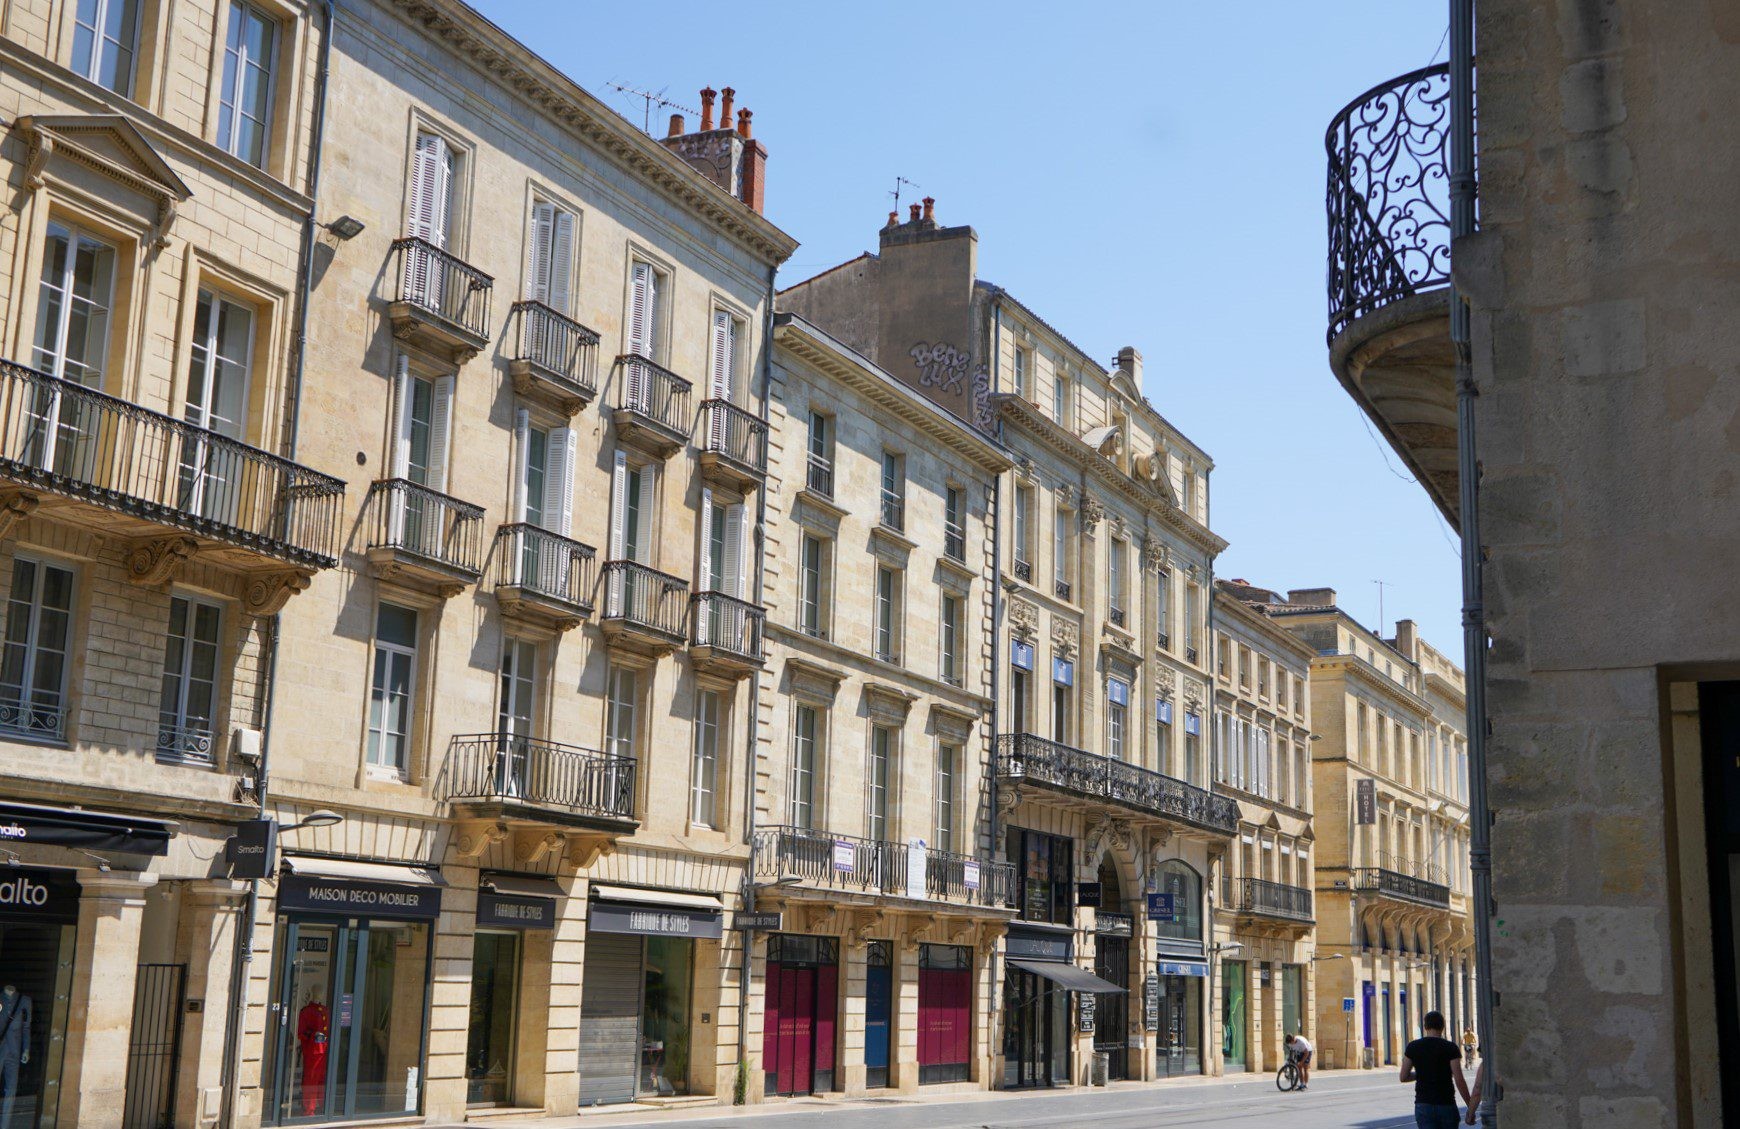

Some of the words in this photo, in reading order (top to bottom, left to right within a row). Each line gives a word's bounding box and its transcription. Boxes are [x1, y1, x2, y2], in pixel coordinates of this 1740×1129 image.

[237, 845, 264, 854] Smalto
[0, 877, 48, 906] alto
[308, 886, 348, 902] MAISON
[349, 889, 377, 904] DECO
[378, 892, 419, 907] MOBILIER
[629, 911, 660, 931] FABRIQUE
[661, 913, 670, 932] DE
[669, 914, 690, 933] STYLES
[272, 1002, 280, 1011] 23
